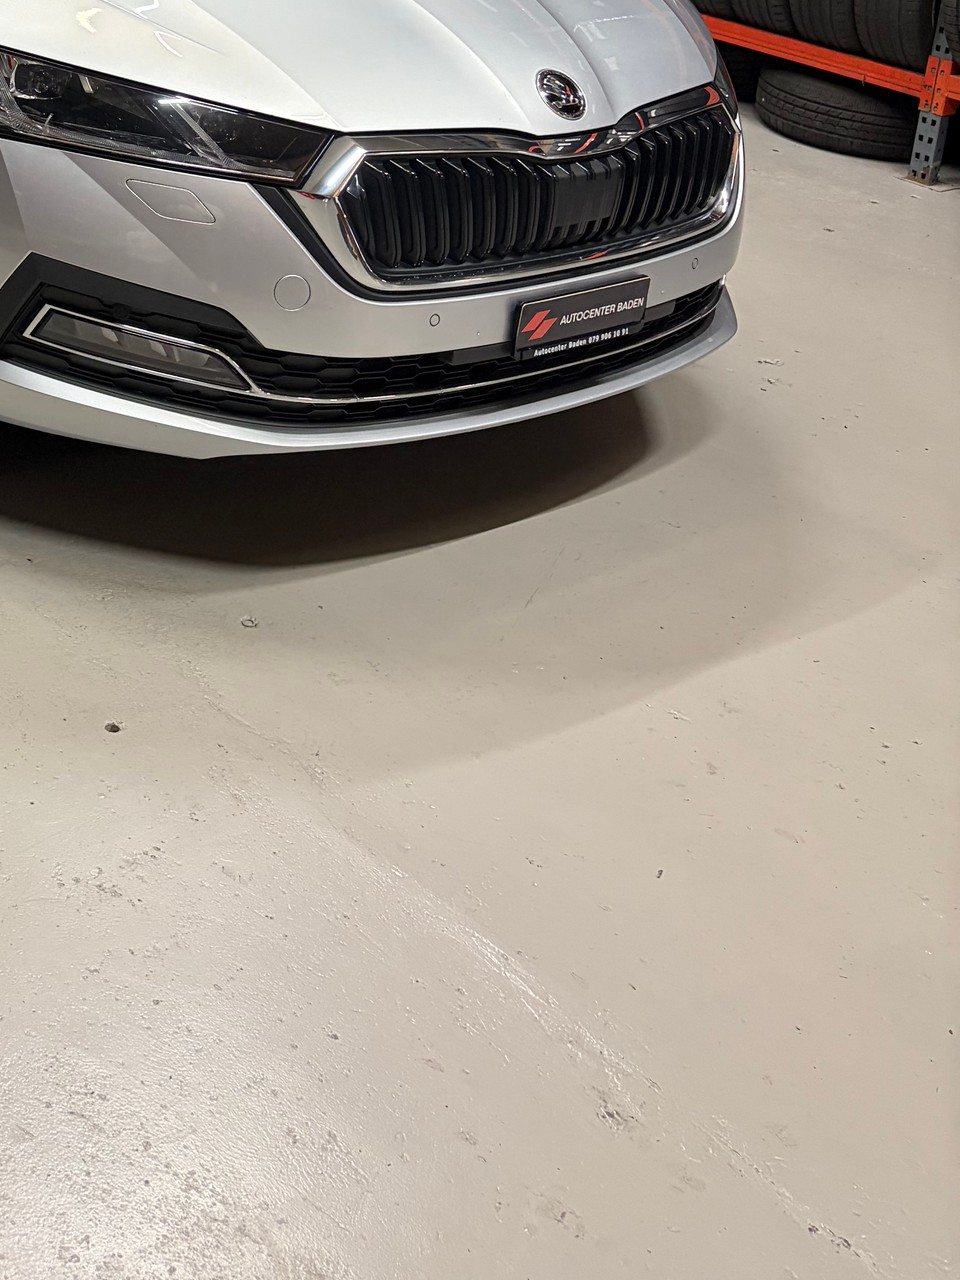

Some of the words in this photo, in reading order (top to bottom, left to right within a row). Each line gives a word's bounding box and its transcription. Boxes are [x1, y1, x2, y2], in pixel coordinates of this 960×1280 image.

[559, 304, 617, 325] AUTOCENTER
[617, 297, 644, 312] BADEN
[534, 343, 567, 357] Autocenter
[568, 338, 587, 348] Baden
[588, 335, 599, 344] 079
